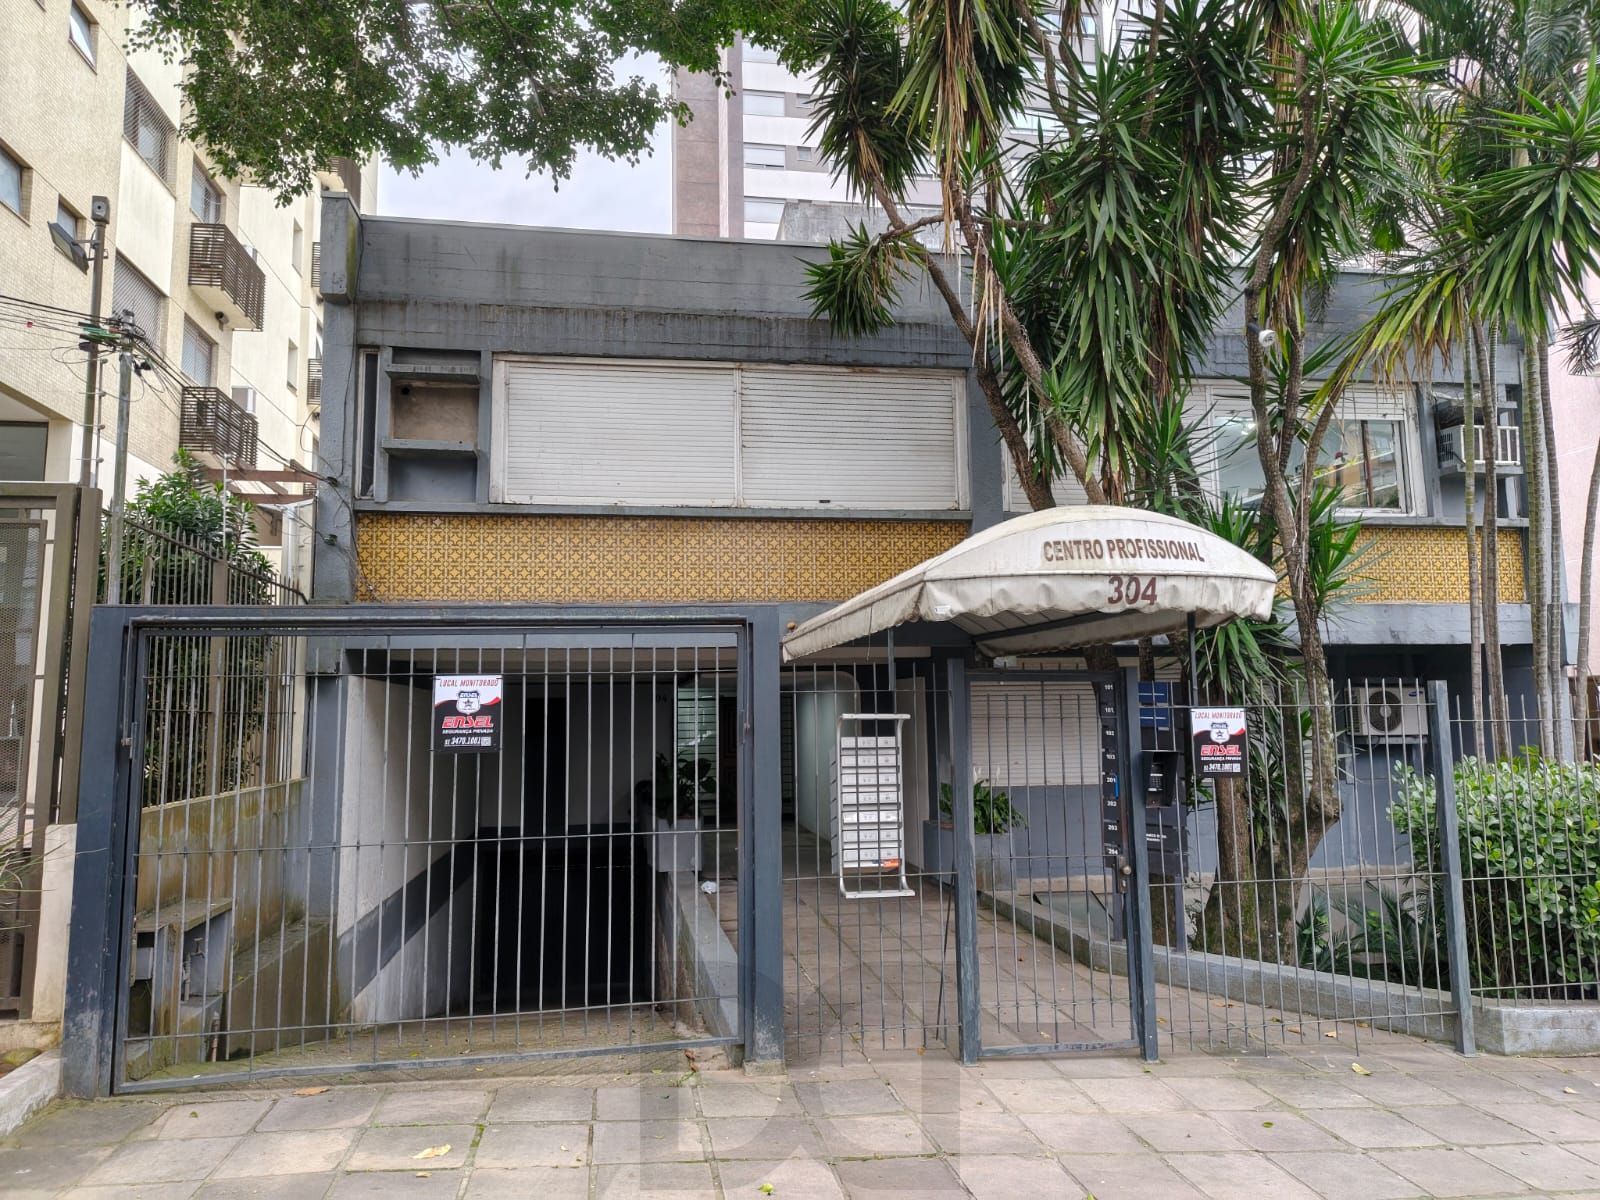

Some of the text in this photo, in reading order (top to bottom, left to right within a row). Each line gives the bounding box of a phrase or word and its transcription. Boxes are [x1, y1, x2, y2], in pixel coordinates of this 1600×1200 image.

[1043, 537, 1205, 562] CENTRO PROFISSIONAL
[1107, 575, 1158, 606] 304
[439, 679, 499, 687] LOCAL MONITORADO
[1194, 711, 1243, 719] LOCAL MONITORADO
[442, 716, 494, 728] ENSEL
[1200, 744, 1242, 756] ENSEL
